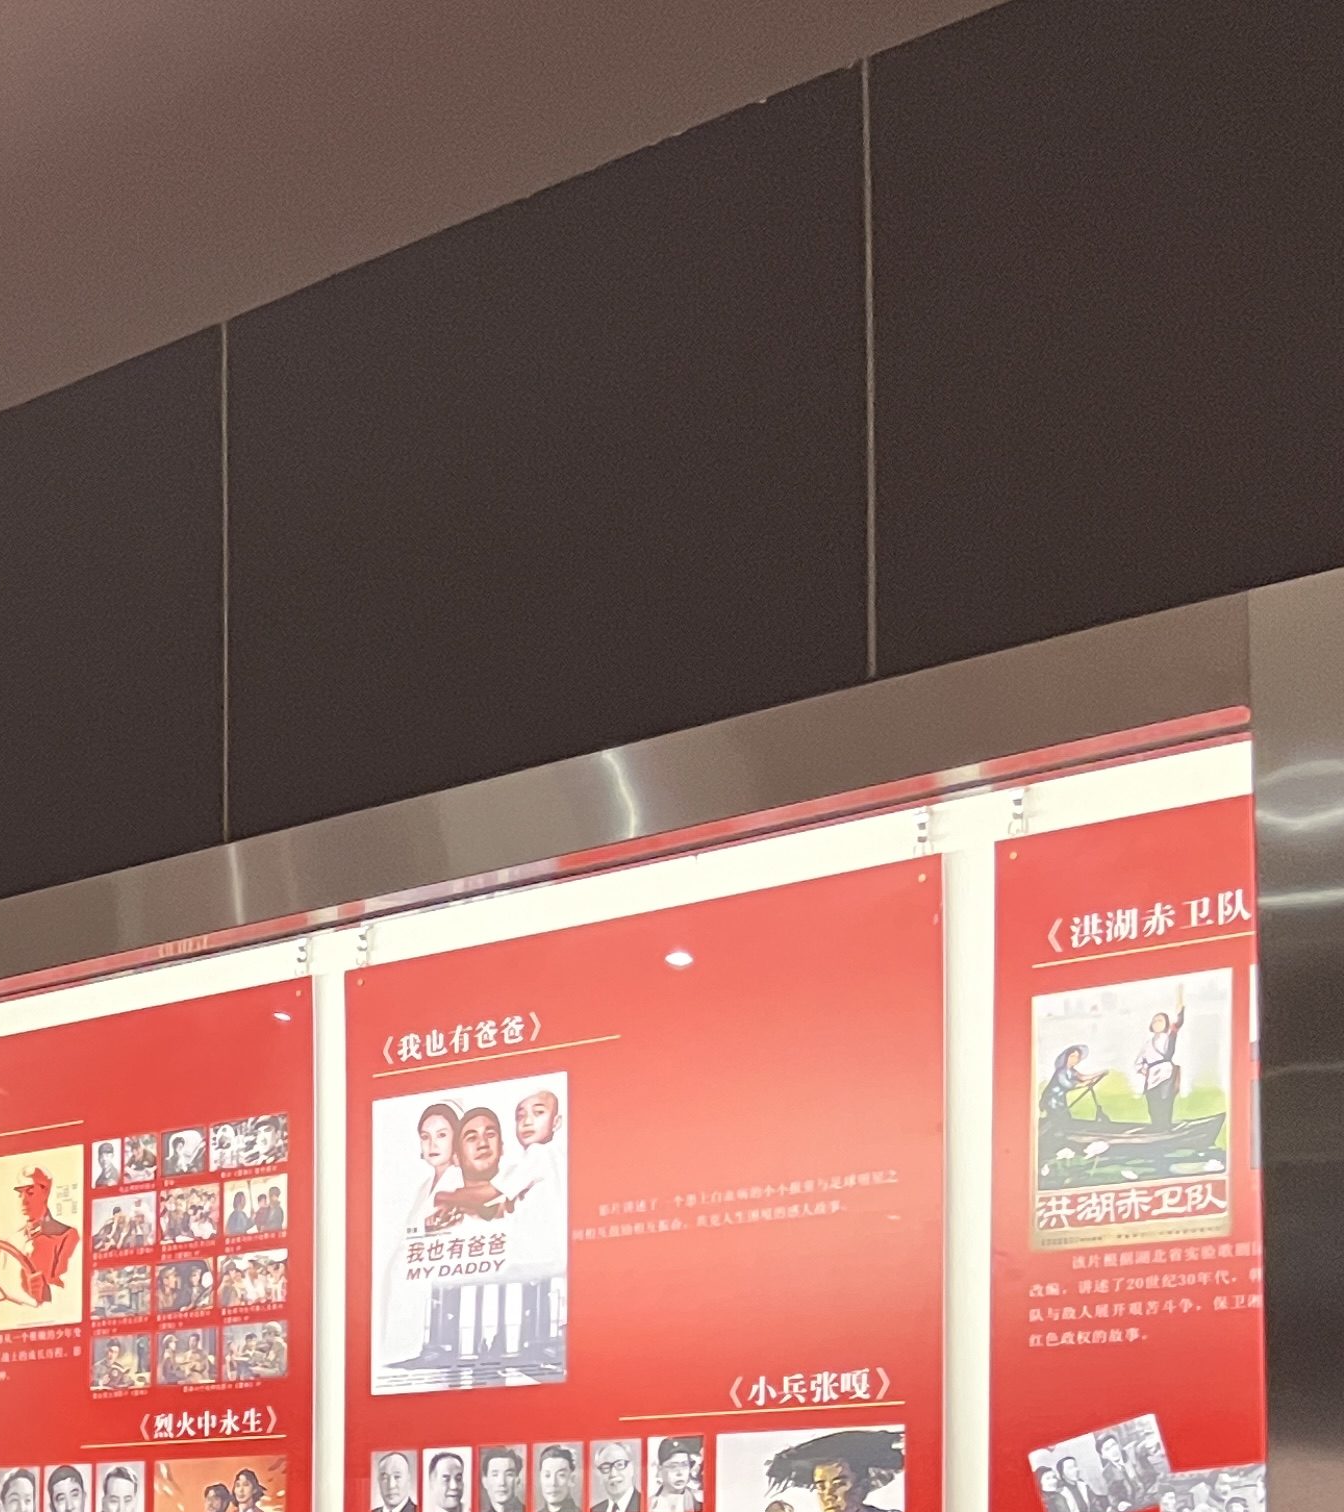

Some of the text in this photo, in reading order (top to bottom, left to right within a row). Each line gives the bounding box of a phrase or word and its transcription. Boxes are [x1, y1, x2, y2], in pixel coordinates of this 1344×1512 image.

[1047, 888, 1252, 953] 《洪湖赤卫队
[382, 1011, 542, 1065] 《我也有爸爸》
[1036, 1183, 1228, 1229] 洪湖赤卫队
[406, 1232, 507, 1264] 我也有爸爸
[406, 1258, 506, 1281] MY DADDY
[1028, 1327, 1148, 1347] 红色政权的故事。
[729, 1367, 891, 1408] 《小兵张嘎》
[140, 1405, 277, 1441] 《烈火中永生》
